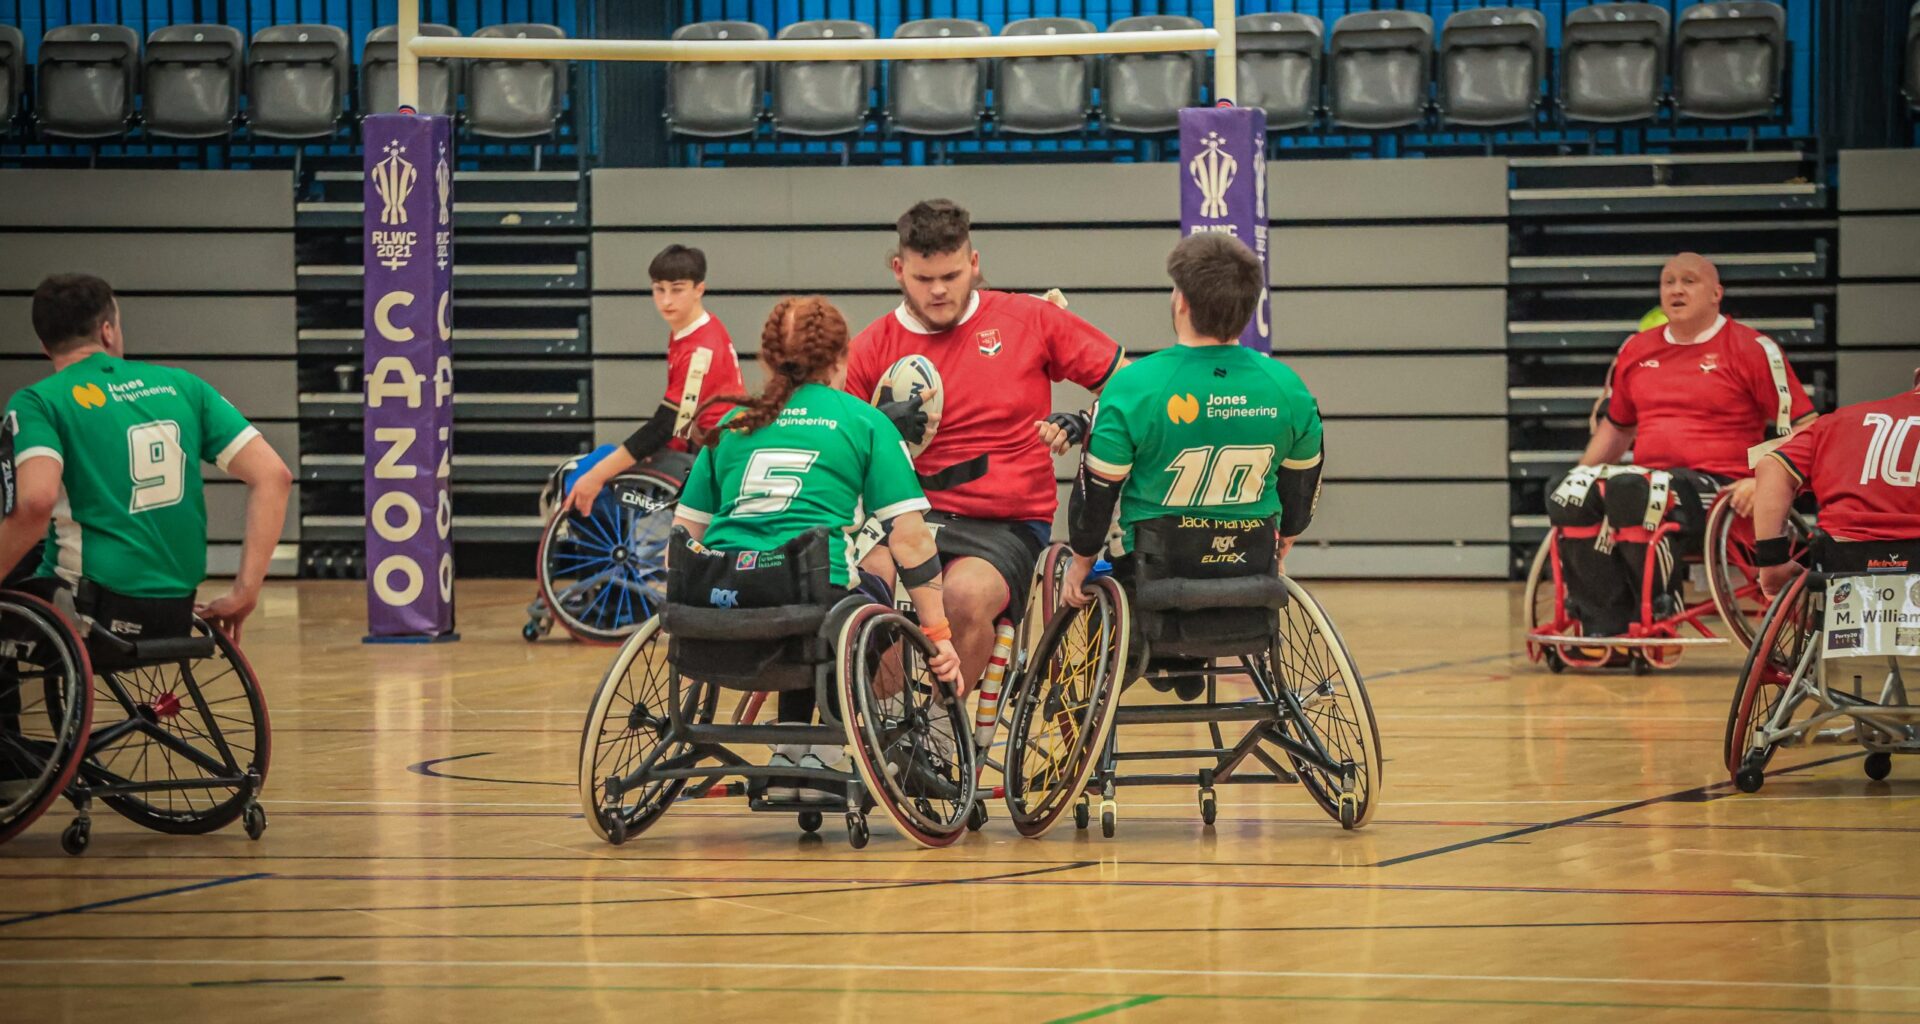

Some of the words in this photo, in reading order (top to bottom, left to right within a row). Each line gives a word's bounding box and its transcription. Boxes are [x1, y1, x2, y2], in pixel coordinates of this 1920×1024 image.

[372, 231, 417, 245] RLWC
[376, 245, 413, 257] 2021
[107, 379, 145, 393] Jones
[1206, 393, 1248, 406] Jones
[781, 407, 808, 416] nes
[1206, 406, 1279, 419] Engineering
[776, 416, 838, 430] gineering
[364, 290, 426, 607] CAZOO
[1860, 412, 1920, 487] 10
[127, 419, 187, 514] 9
[1160, 444, 1276, 507] 10
[729, 448, 820, 519] 5
[1178, 515, 1210, 529] Jack
[1214, 519, 1265, 532] Mangan
[1211, 535, 1238, 553] RGK
[1201, 551, 1247, 564] ELITEX
[1876, 587, 1895, 601] 10
[1836, 611, 1855, 625] M.
